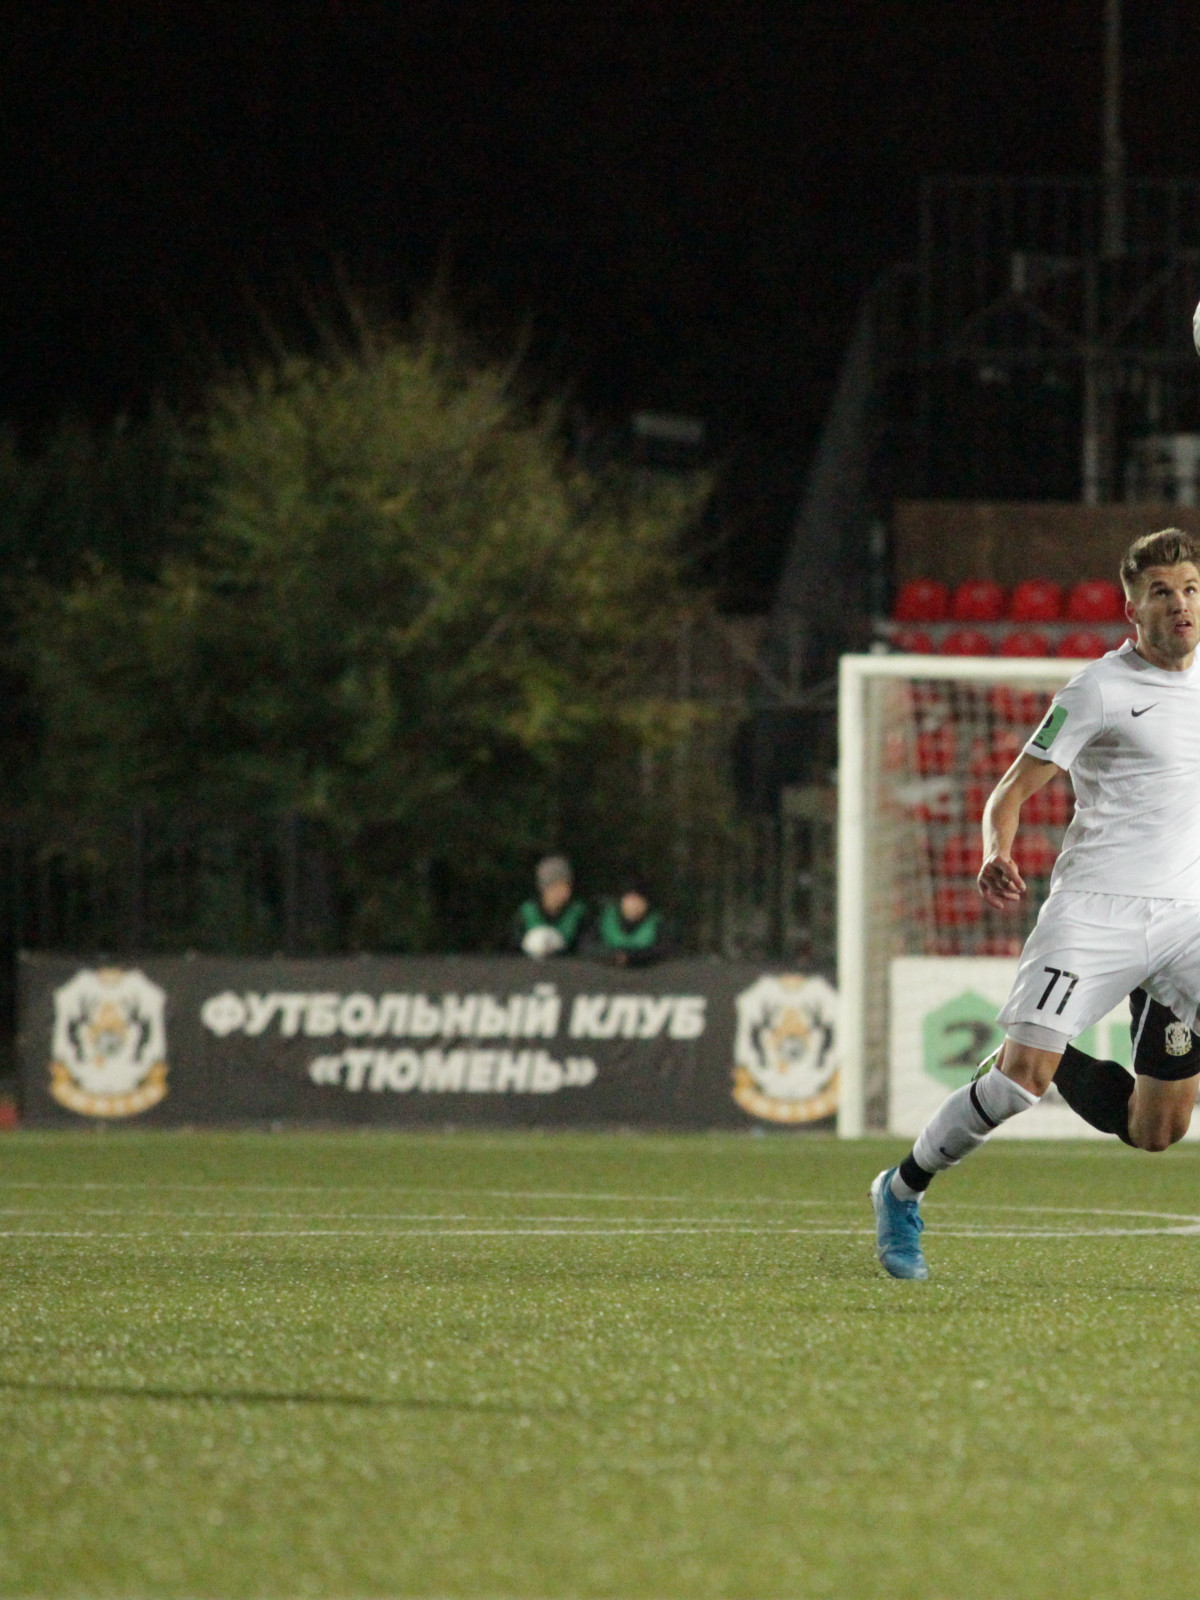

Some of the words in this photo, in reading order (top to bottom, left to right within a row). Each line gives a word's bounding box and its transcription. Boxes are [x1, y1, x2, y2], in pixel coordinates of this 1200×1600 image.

[201, 983, 561, 1038] ФУТБОЛЬНЫЙ
[568, 994, 707, 1039] КЛУБ
[1035, 965, 1080, 1016] 77
[308, 1049, 598, 1093] «ТЮМЕНЬ»
